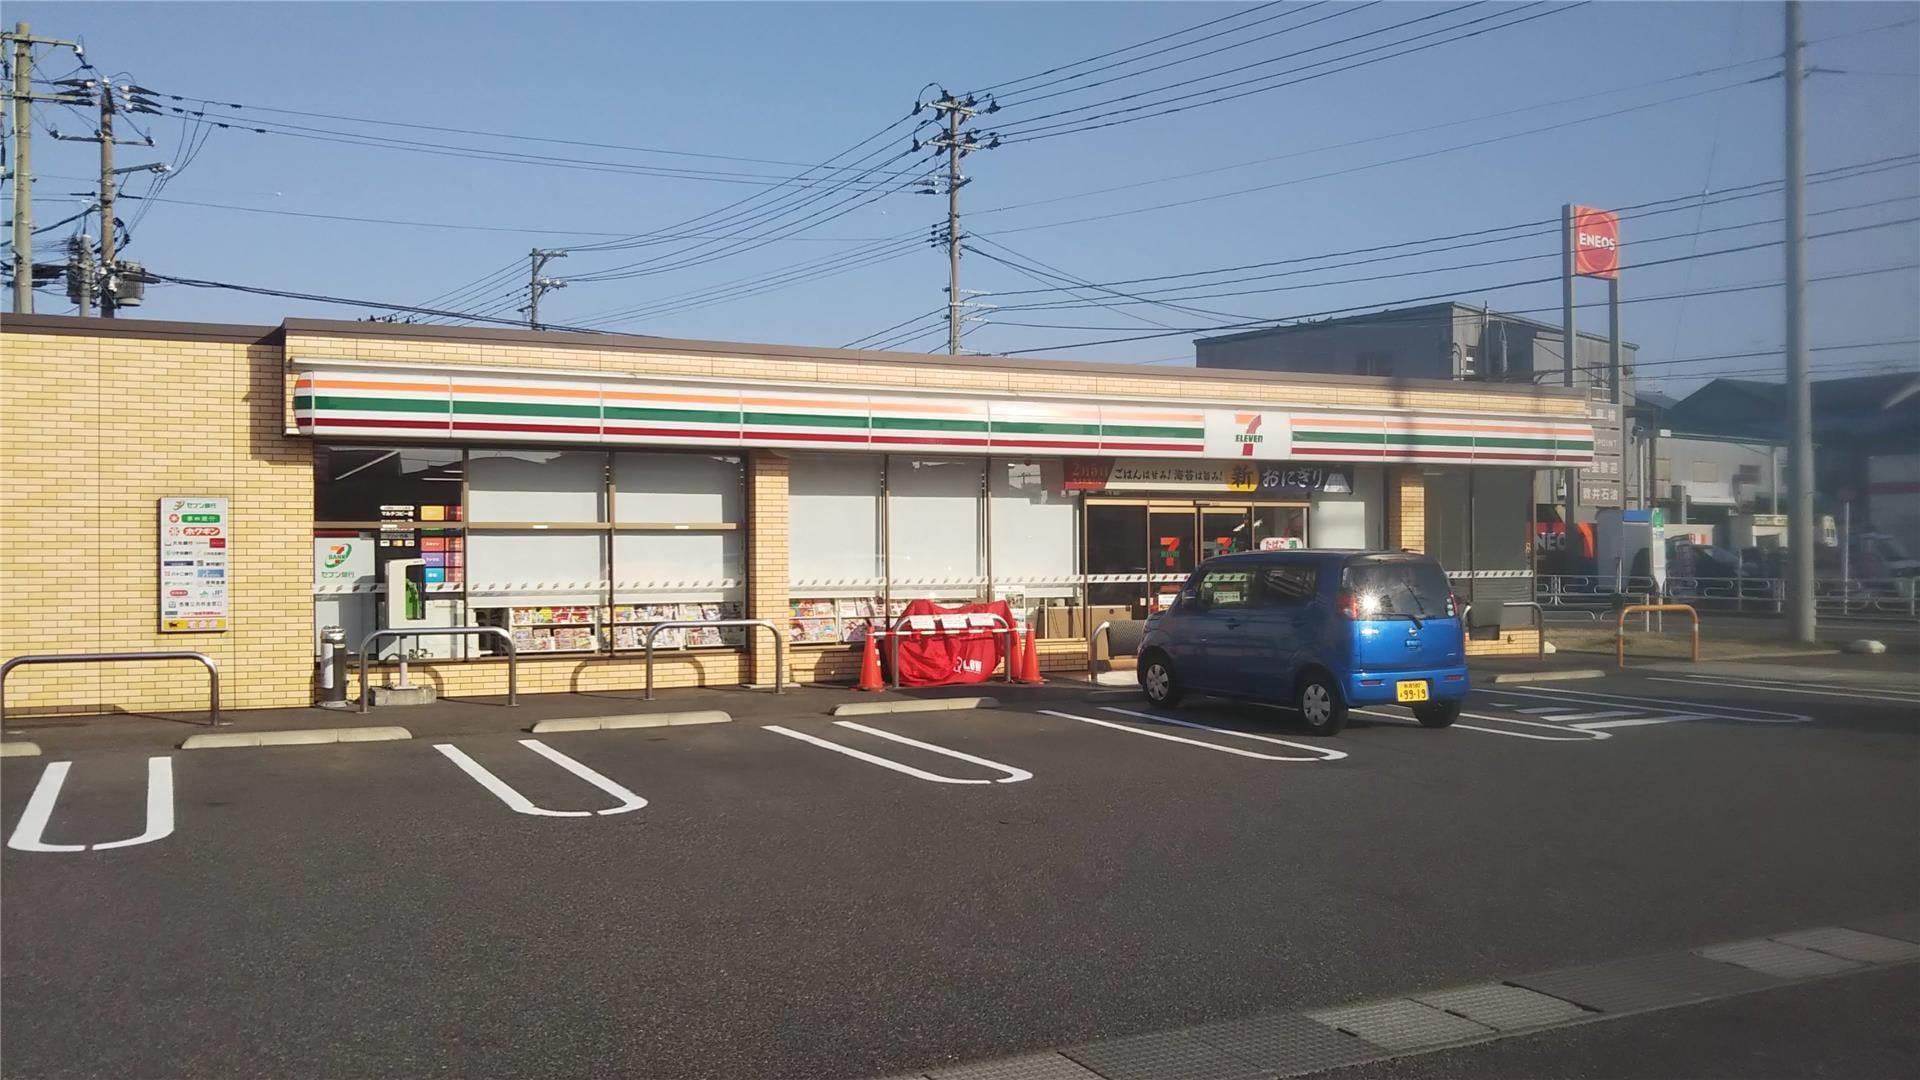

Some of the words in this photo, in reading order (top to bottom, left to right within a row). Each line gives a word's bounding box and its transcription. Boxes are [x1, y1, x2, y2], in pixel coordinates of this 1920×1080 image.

[1579, 232, 1616, 251] ENEOS
[1232, 464, 1254, 489] 新
[1262, 467, 1322, 488] おにぎり
[1404, 688, 1426, 700] 99-19
